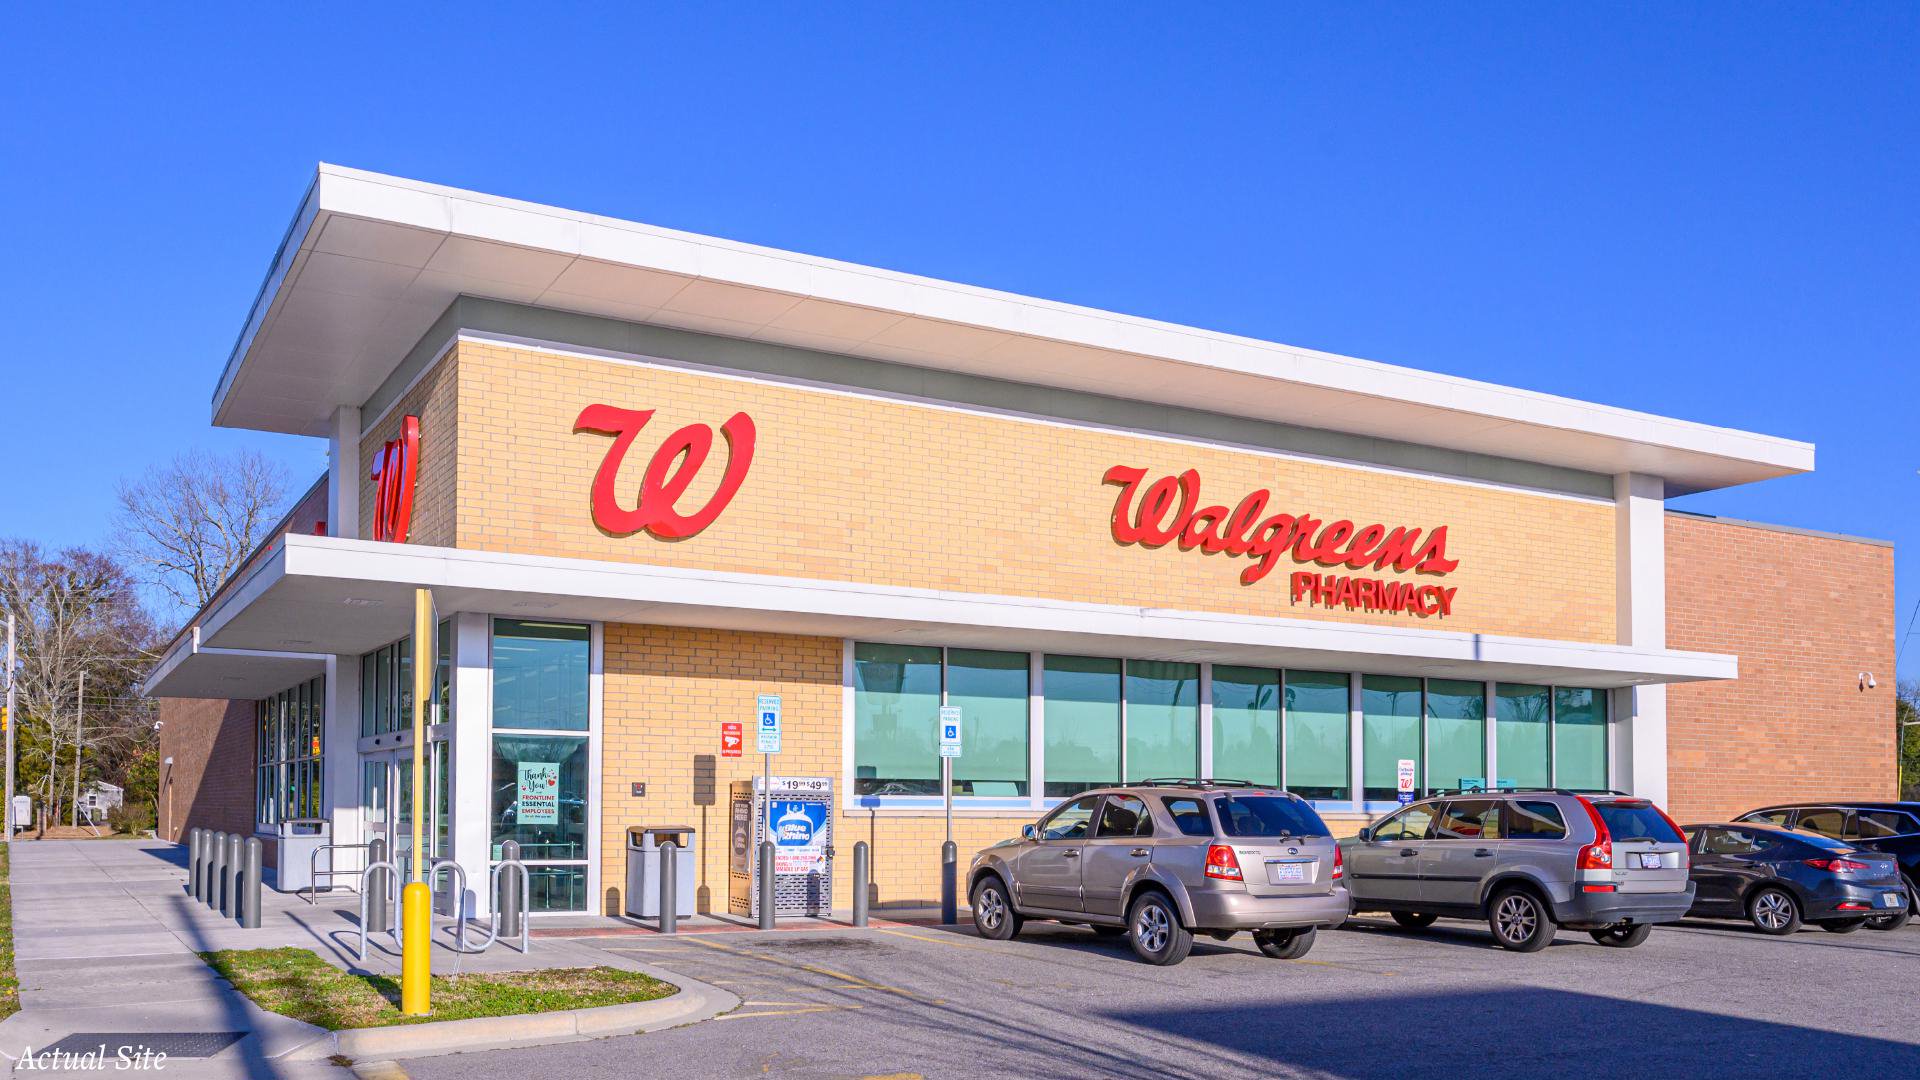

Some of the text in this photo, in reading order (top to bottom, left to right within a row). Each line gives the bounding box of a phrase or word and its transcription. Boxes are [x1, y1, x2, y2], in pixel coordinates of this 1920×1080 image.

[573, 403, 757, 540] W
[1102, 464, 1460, 586] Walgreens
[1291, 571, 1458, 616] PHARMACY
[524, 767, 548, 781] Thank
